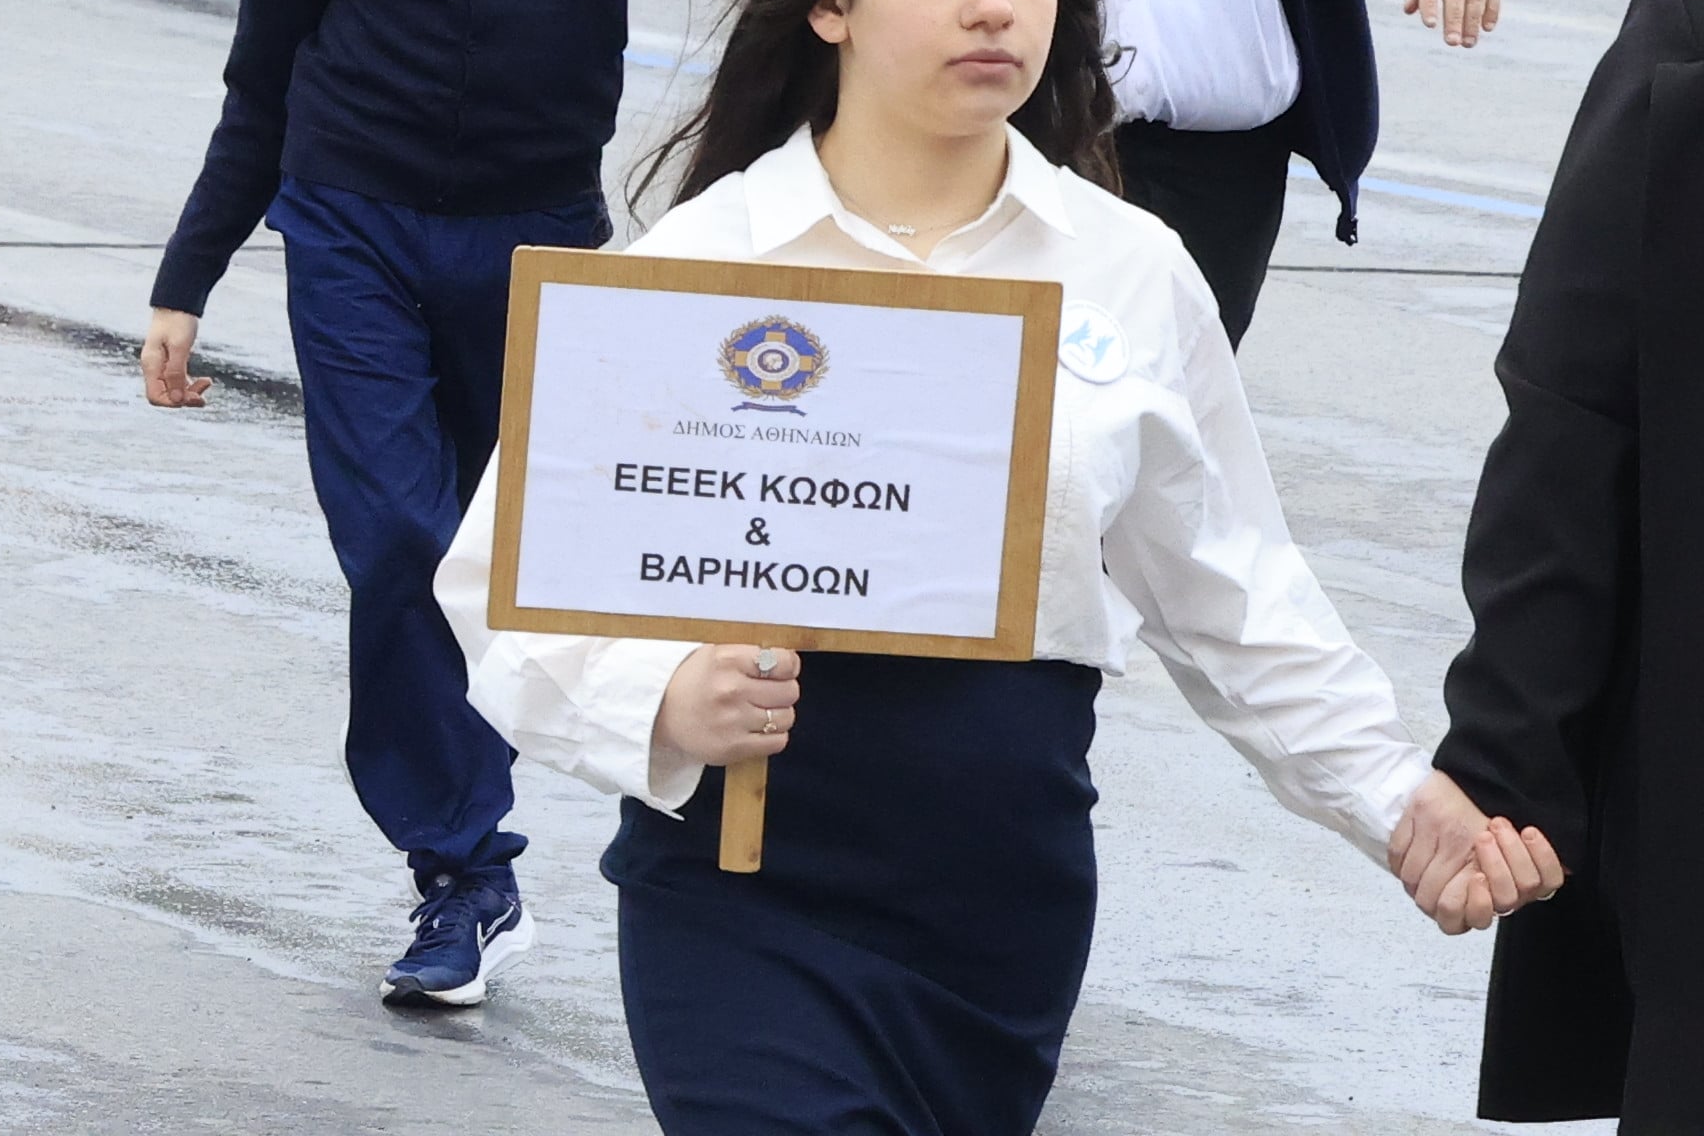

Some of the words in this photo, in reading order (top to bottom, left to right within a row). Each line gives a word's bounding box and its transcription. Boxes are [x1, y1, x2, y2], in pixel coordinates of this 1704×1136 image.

[672, 420, 747, 440] ΔΗΜΟΣ
[750, 426, 863, 448] ΑΘΗΝΑΙΩΝ
[614, 462, 747, 501] ΕΕΕΕΚ
[759, 473, 912, 513] ΚΩΦΩΝ
[744, 516, 772, 547] &
[639, 552, 870, 598] ΒΑΡΗΚΟΩΝ
